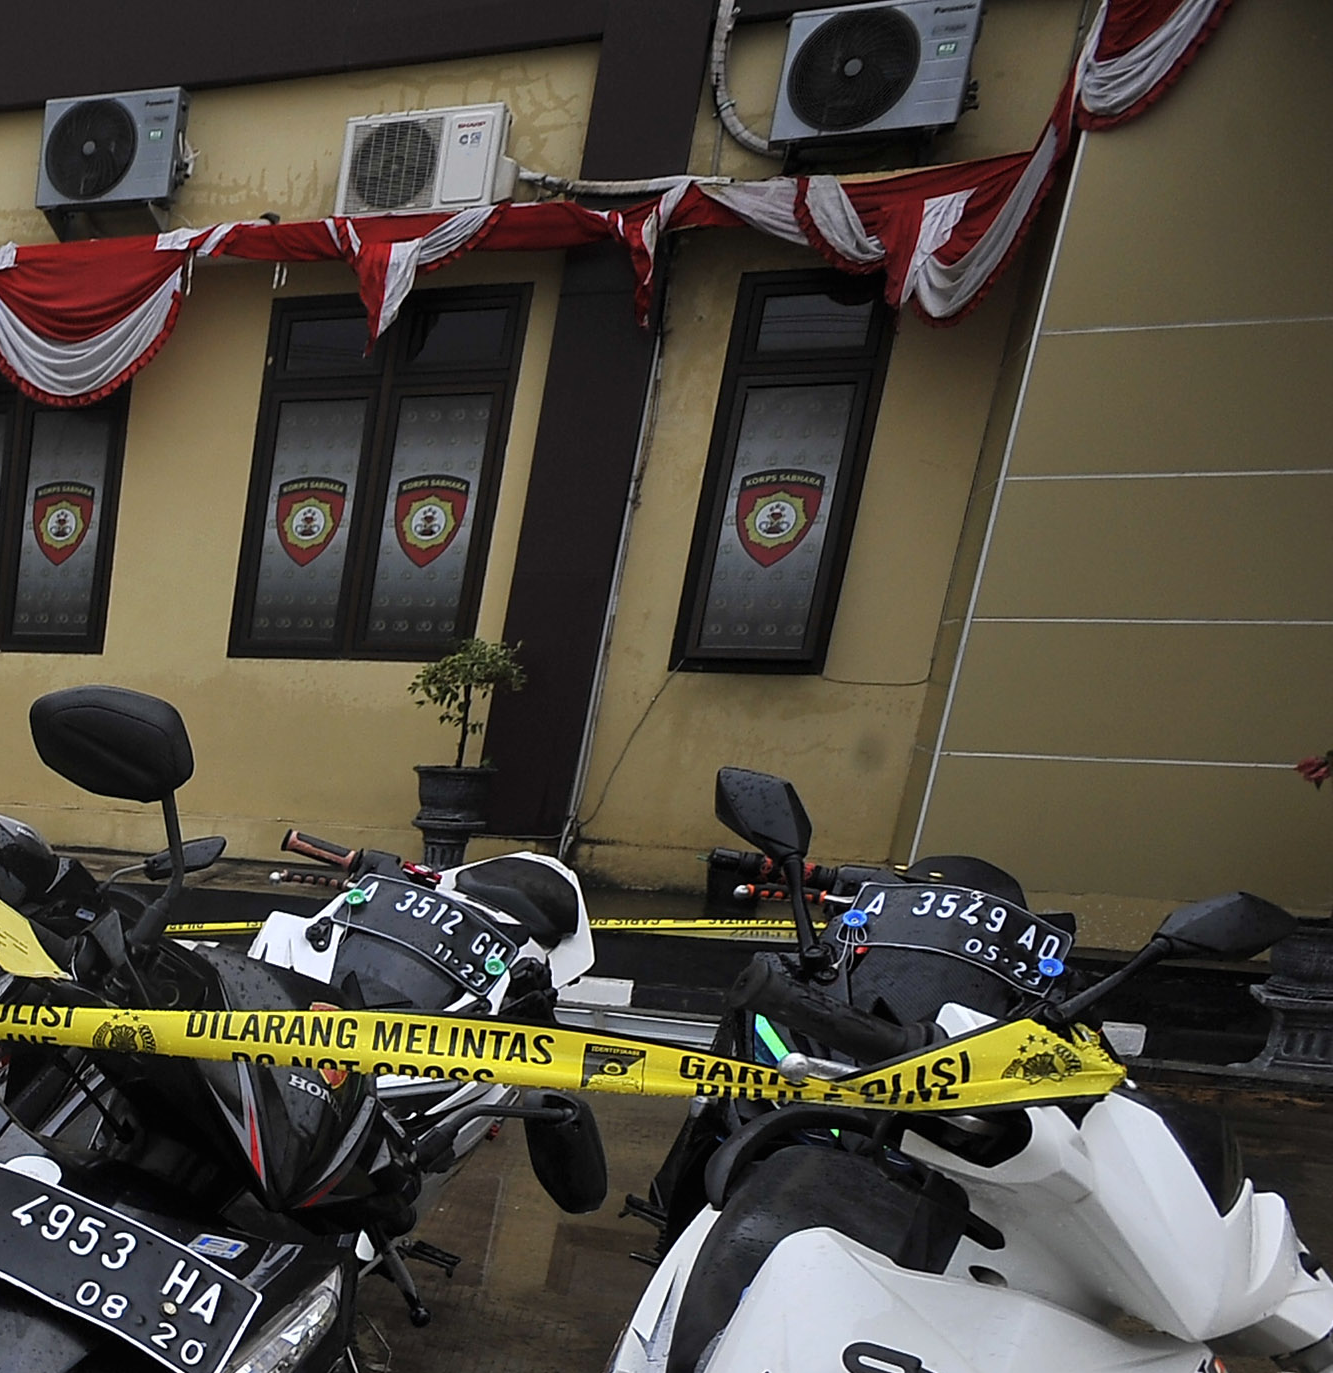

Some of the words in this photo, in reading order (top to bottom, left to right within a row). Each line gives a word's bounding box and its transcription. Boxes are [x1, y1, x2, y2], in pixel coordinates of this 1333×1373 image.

[38, 486, 61, 497] KORPS
[62, 485, 93, 497] SABHARA
[283, 481, 309, 492] KORPS
[309, 481, 344, 493] SABHARA
[402, 479, 429, 491] KORPS
[431, 478, 466, 491] SABHARA
[745, 475, 777, 487] KORPS
[779, 474, 821, 486] SABHARA
[364, 881, 380, 902] A
[394, 890, 464, 936] 3512
[864, 892, 885, 915] A
[185, 1009, 359, 1050] DILARANG
[371, 1020, 556, 1066] MELINTAS
[288, 1073, 334, 1104] HON
[11, 1195, 137, 1271] 4953
[161, 1259, 223, 1325] HA
